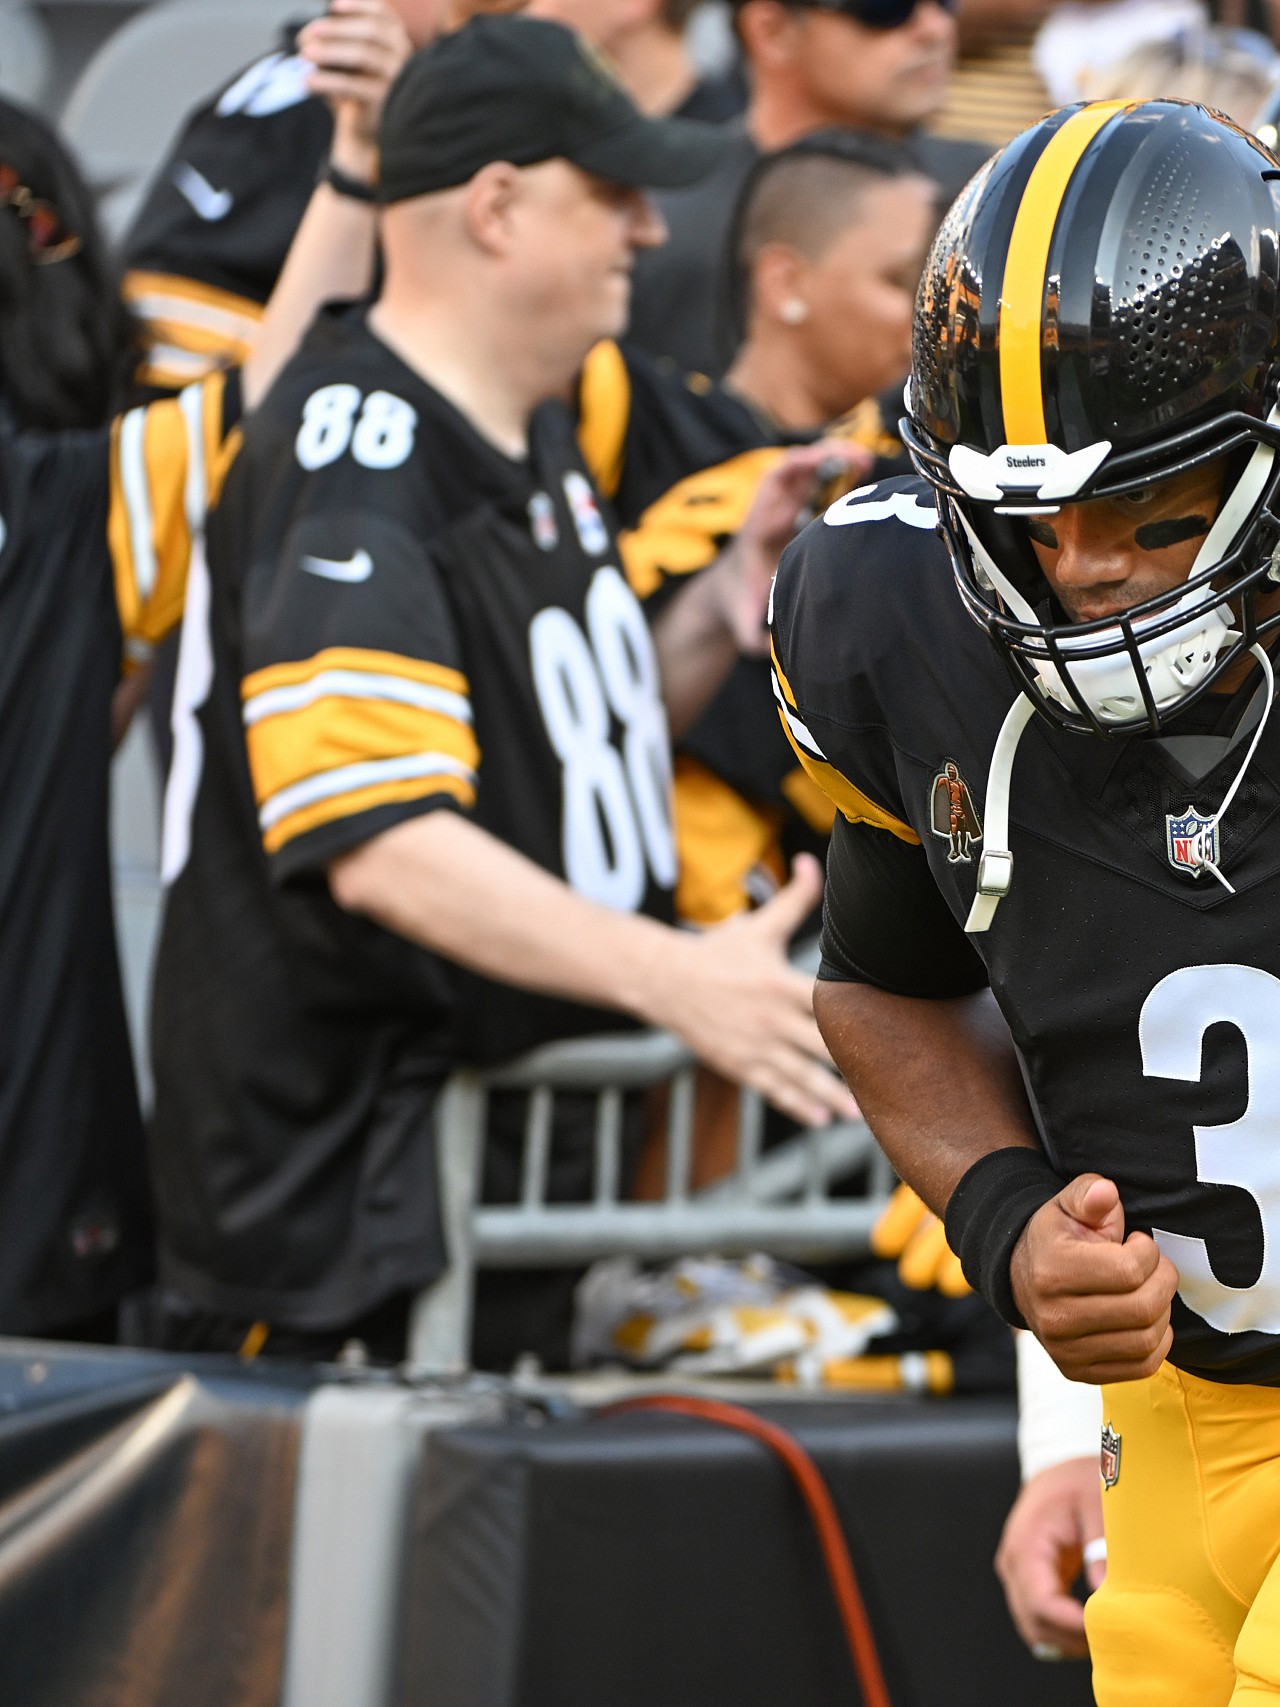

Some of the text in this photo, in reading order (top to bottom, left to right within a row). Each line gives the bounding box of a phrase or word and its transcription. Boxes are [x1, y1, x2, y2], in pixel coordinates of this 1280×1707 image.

[295, 383, 418, 471] 88
[1006, 455, 1046, 468] Steelers
[823, 484, 940, 530] 3
[529, 564, 678, 914] 88
